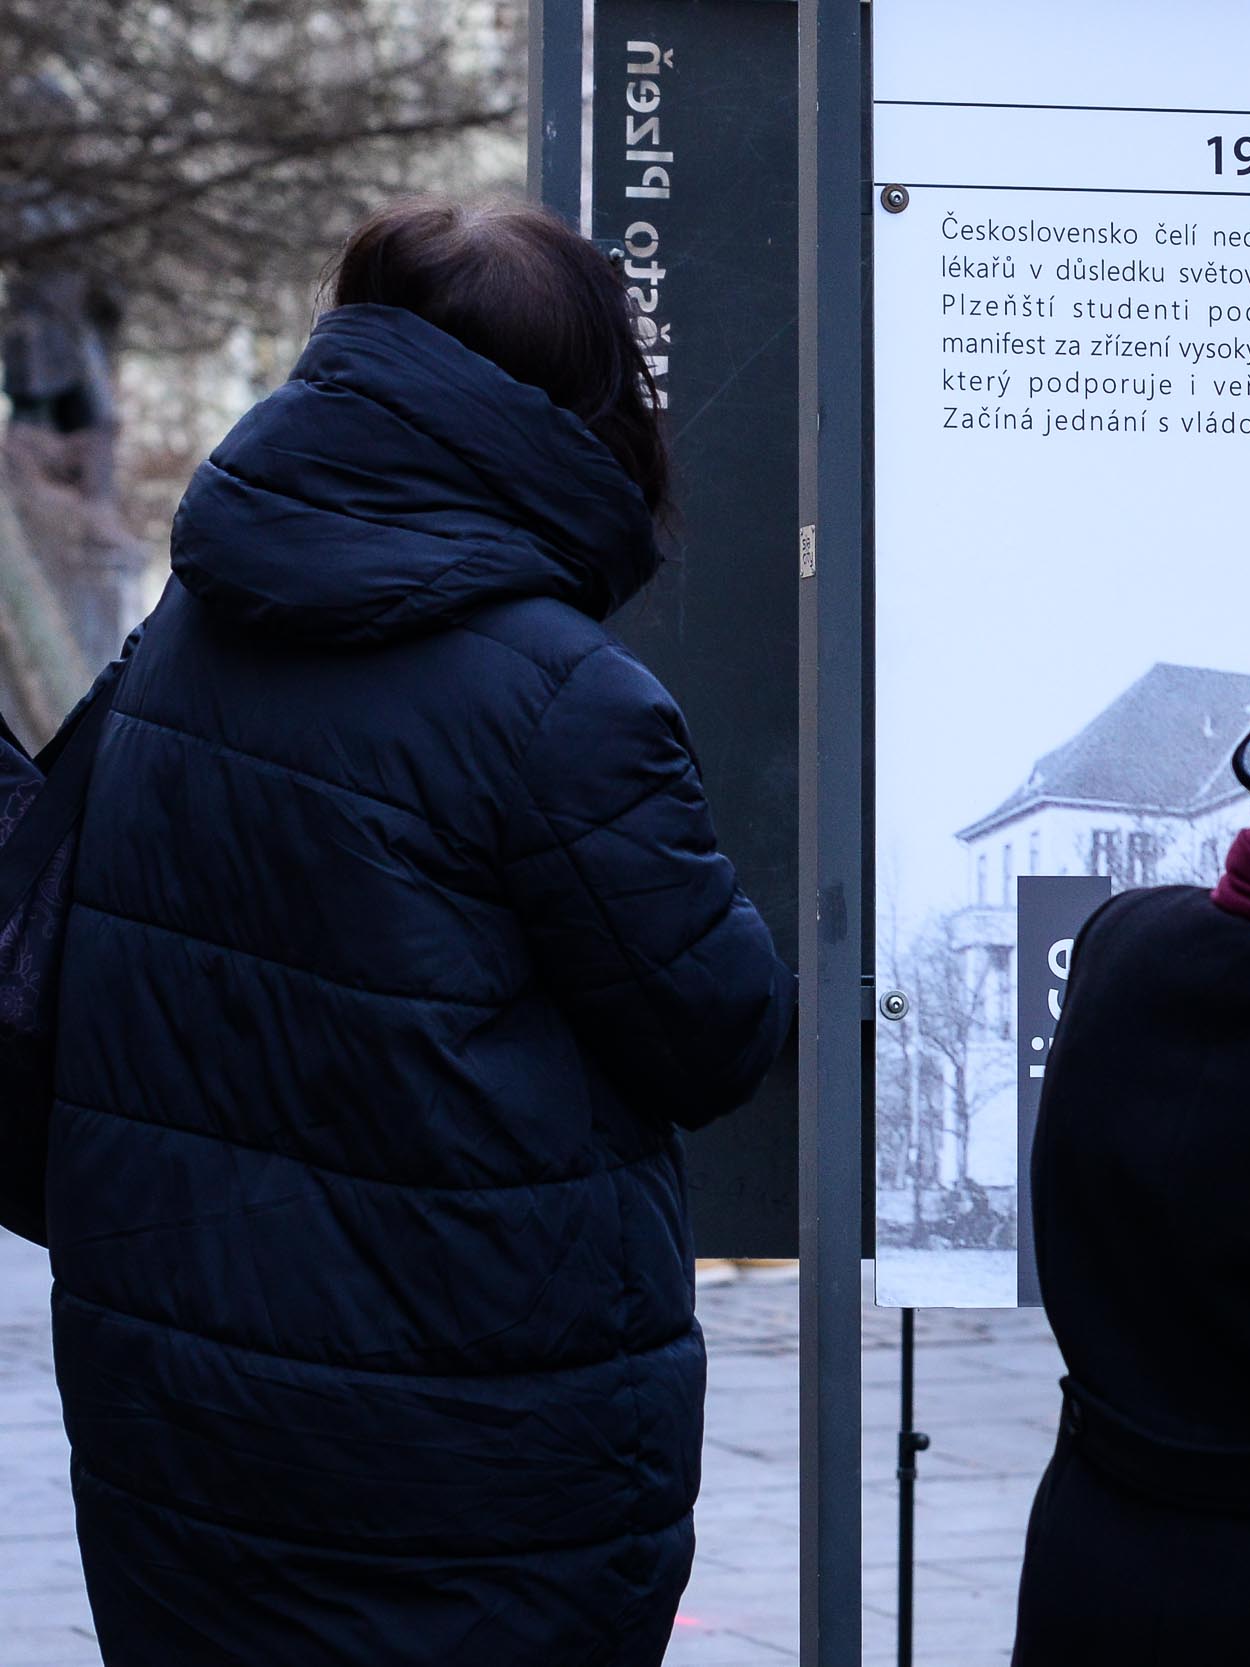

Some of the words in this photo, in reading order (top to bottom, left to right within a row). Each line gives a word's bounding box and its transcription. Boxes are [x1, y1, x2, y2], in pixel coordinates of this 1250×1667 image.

[941, 210, 1138, 245] Československo
[1155, 222, 1198, 247] čelí
[942, 254, 1015, 279] lékařů
[1029, 263, 1043, 280] v
[1056, 257, 1165, 283] důsledku
[942, 292, 1055, 318] Plzeňští
[1073, 296, 1189, 321] studenti
[942, 331, 1046, 356] manifest
[1054, 339, 1081, 356] za
[1090, 333, 1171, 358] zřízení
[943, 367, 1011, 399] který
[1029, 370, 1172, 402] podporuje
[1190, 373, 1195, 396] i
[943, 405, 1033, 431] Začíná
[1041, 408, 1148, 437] jednání
[1158, 416, 1169, 433] s
